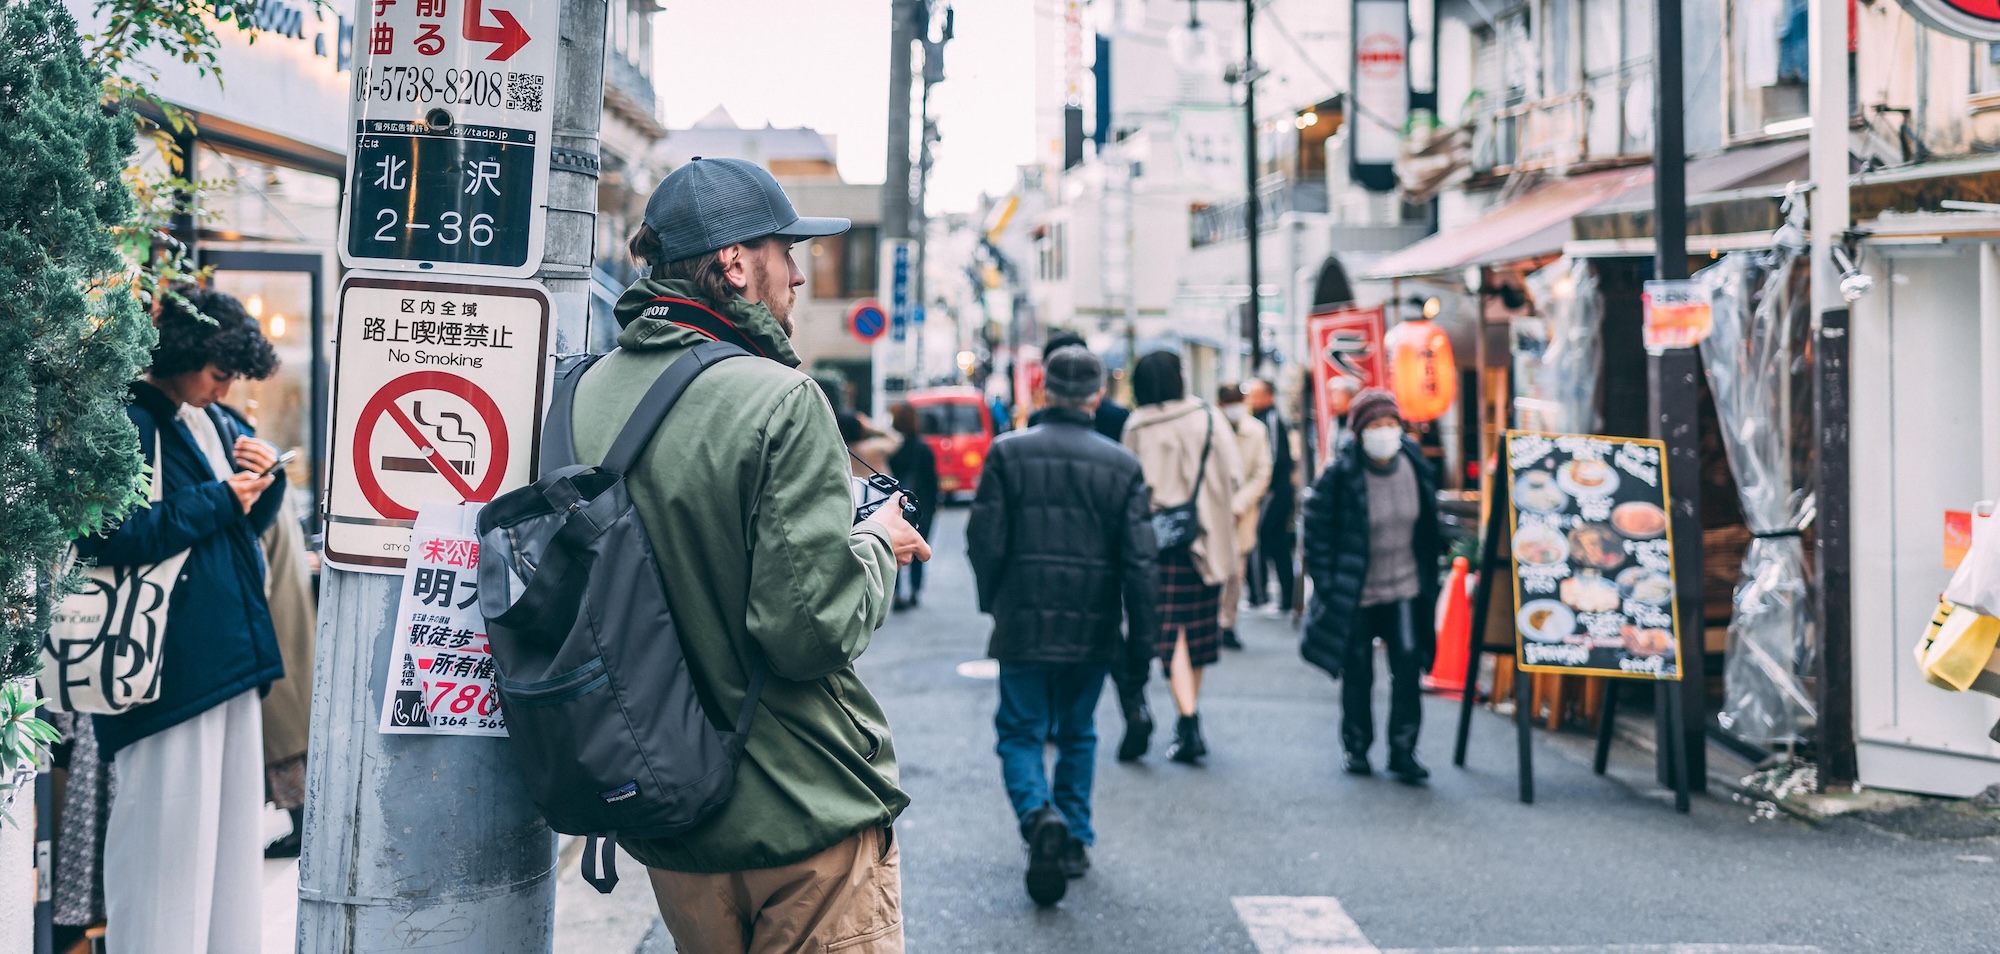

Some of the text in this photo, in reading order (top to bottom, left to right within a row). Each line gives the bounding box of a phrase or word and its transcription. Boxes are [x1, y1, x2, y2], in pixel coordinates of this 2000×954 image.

[356, 66, 503, 107] 03-5738-8208
[401, 298, 478, 318] 区内全域
[362, 317, 513, 349] 路上喫煙禁止
[388, 349, 484, 369] No Smoking
[383, 543, 402, 551] CITY
[606, 789, 637, 803] patagonia
